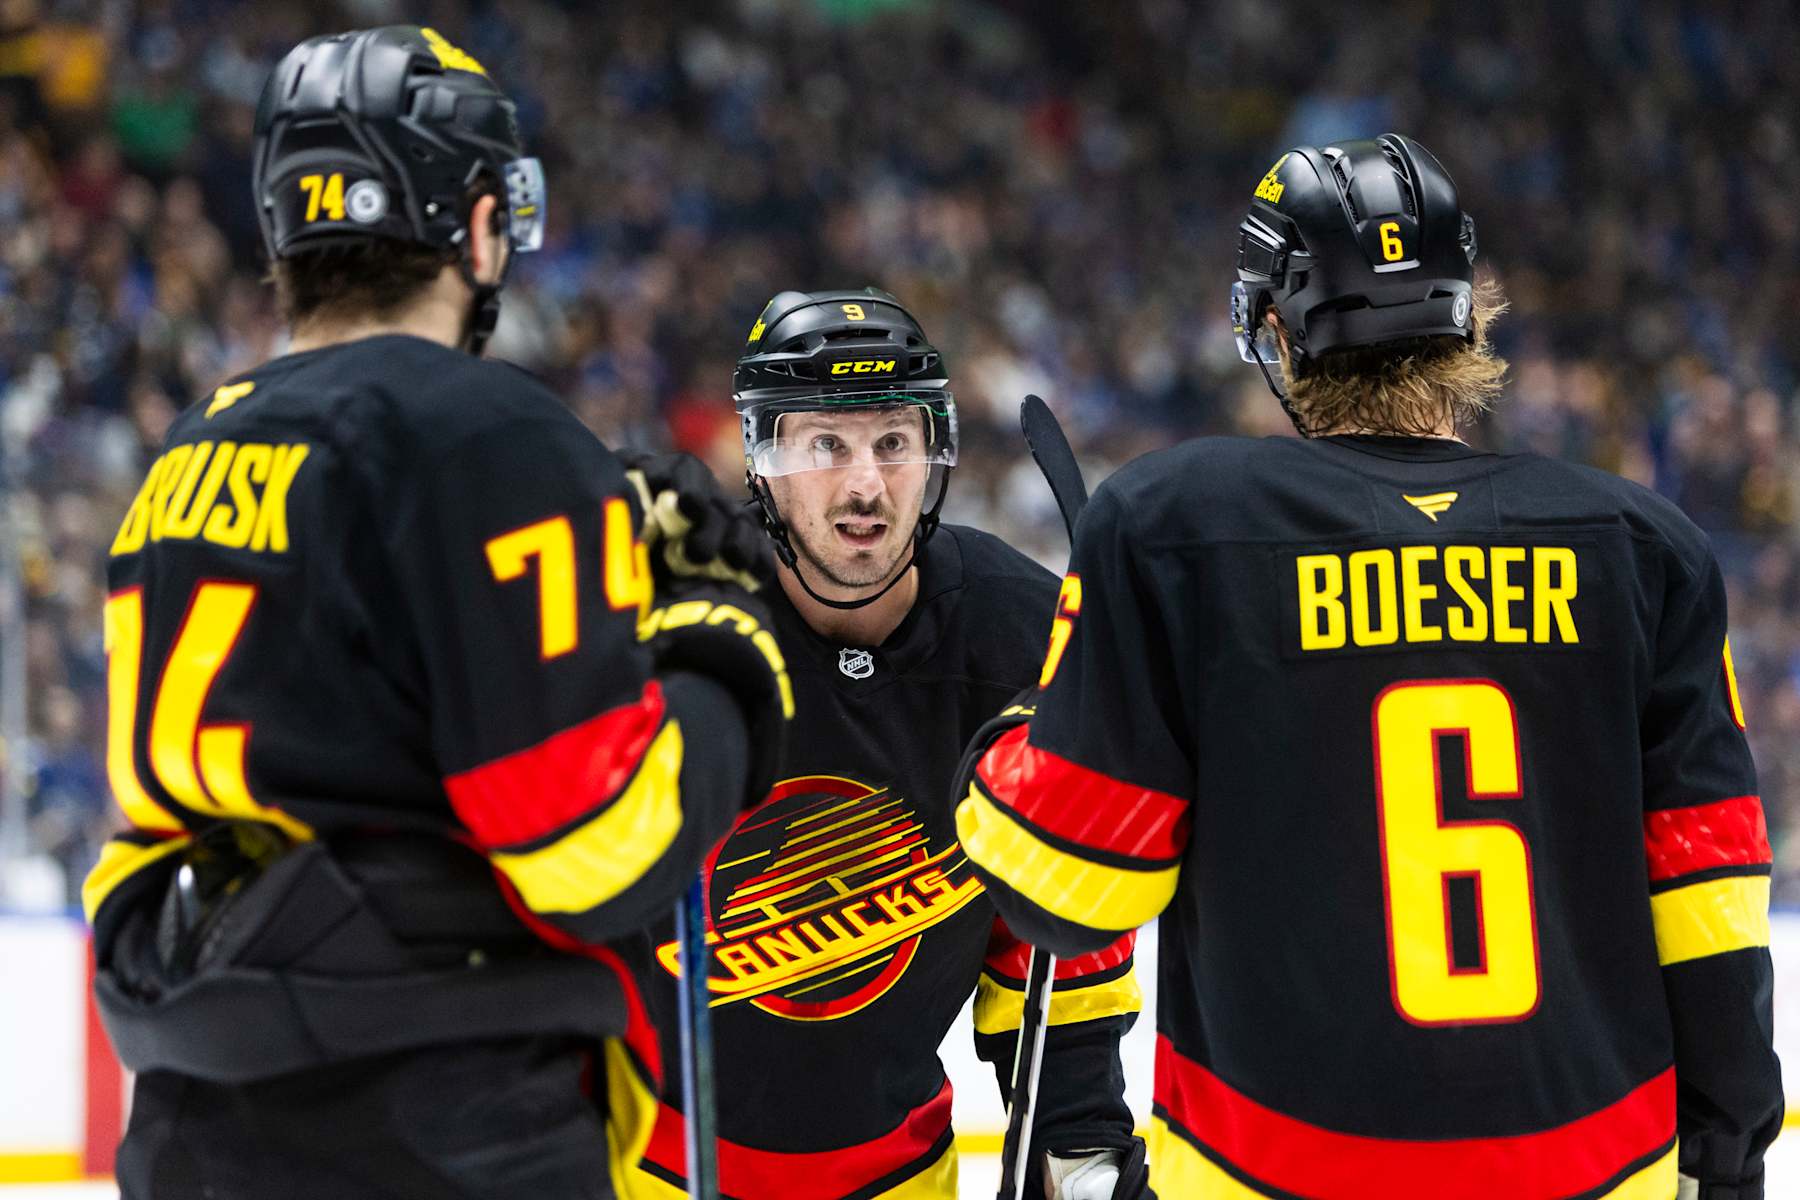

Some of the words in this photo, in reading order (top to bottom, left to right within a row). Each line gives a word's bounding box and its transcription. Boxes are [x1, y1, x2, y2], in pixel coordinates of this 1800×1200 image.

[299, 172, 345, 223] 74
[1379, 221, 1404, 262] 6
[842, 303, 866, 321] 9
[831, 360, 896, 375] CCM
[483, 494, 655, 663] 74
[1296, 545, 1580, 651] BOESER
[1371, 677, 1544, 1029] 6
